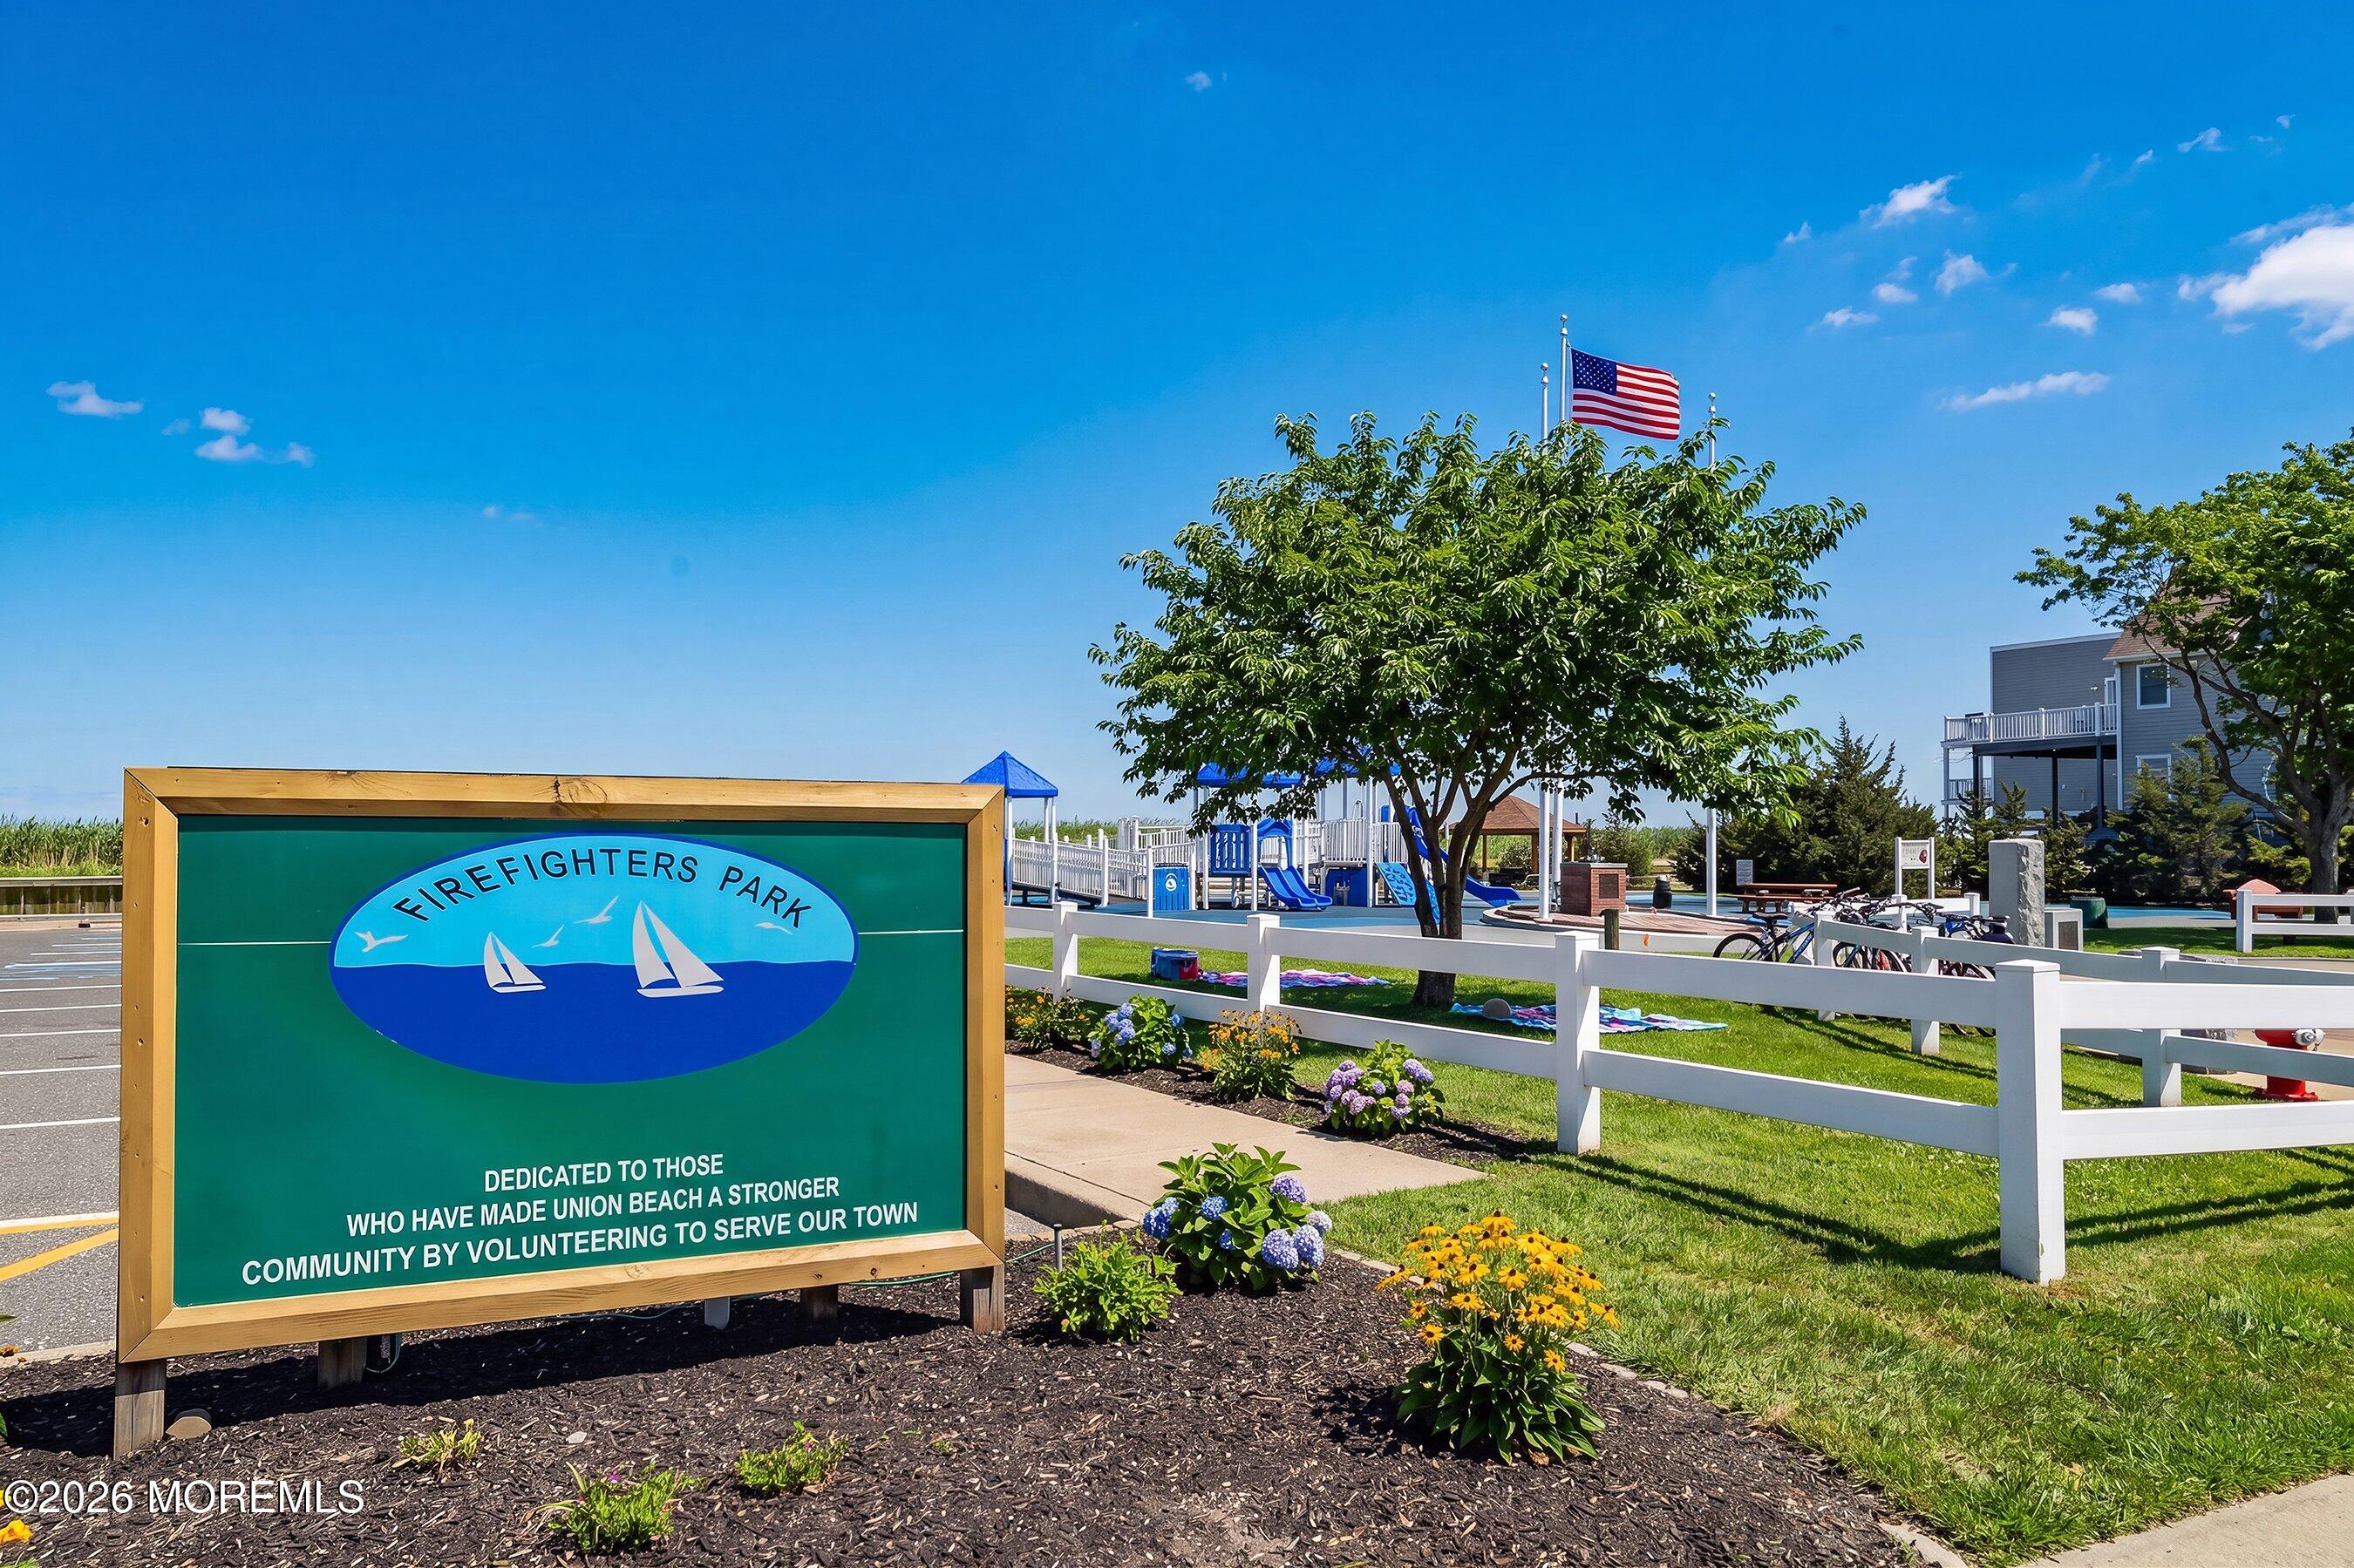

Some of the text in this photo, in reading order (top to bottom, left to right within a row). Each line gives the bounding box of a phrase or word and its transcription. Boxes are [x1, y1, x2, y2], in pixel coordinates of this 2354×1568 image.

[392, 848, 813, 929] FIREFIGHTERS PARK
[346, 1177, 840, 1237] WHO HAVE MADE UNION BEACH A STRONGER
[485, 1153, 724, 1192] DEDICATED TO THOSE
[242, 1201, 917, 1286] COMMUNITY BY VOLUNTEERING TO SERVE OUR TOWN
